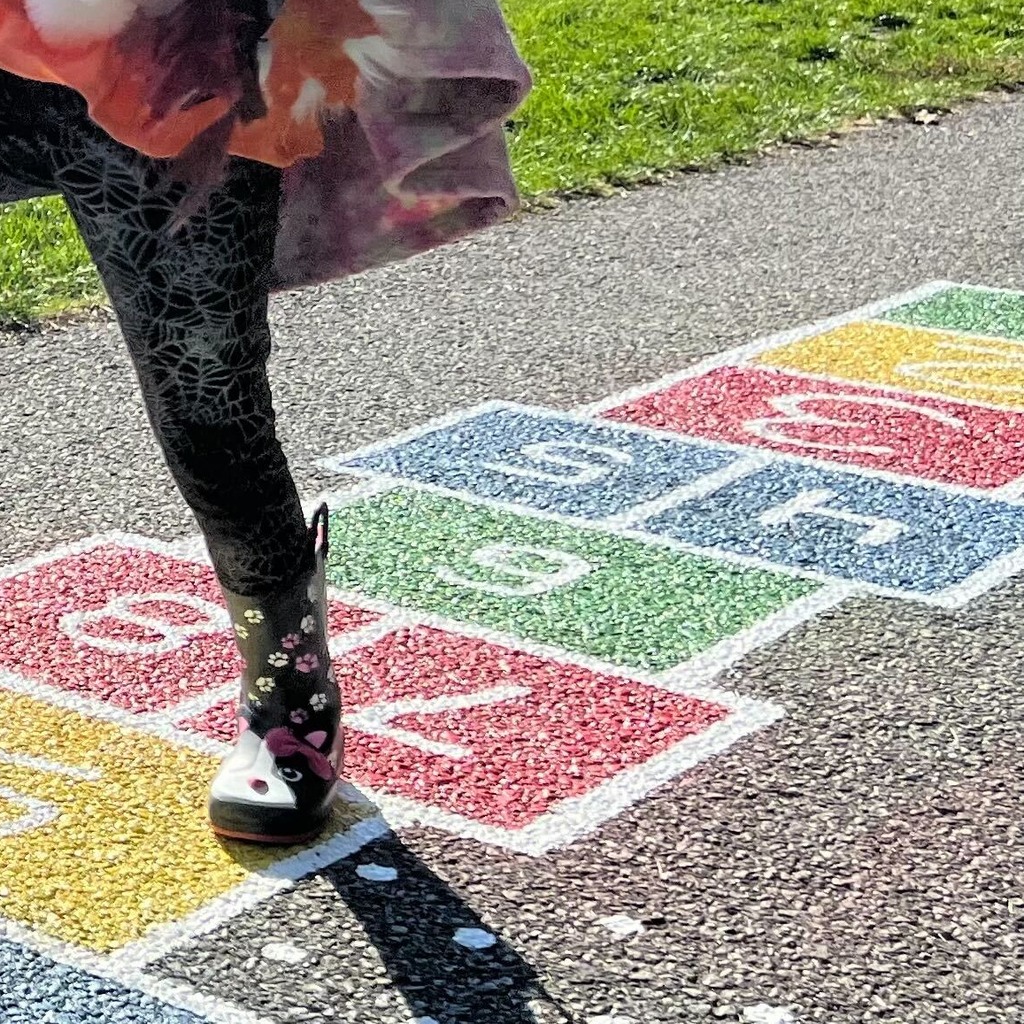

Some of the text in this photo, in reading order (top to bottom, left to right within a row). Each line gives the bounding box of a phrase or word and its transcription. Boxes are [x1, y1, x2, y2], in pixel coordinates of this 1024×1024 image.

[742, 393, 967, 455] 3
[482, 440, 633, 485] 5
[759, 487, 903, 546] 4
[58, 593, 232, 655] 8
[339, 684, 533, 759] 7
